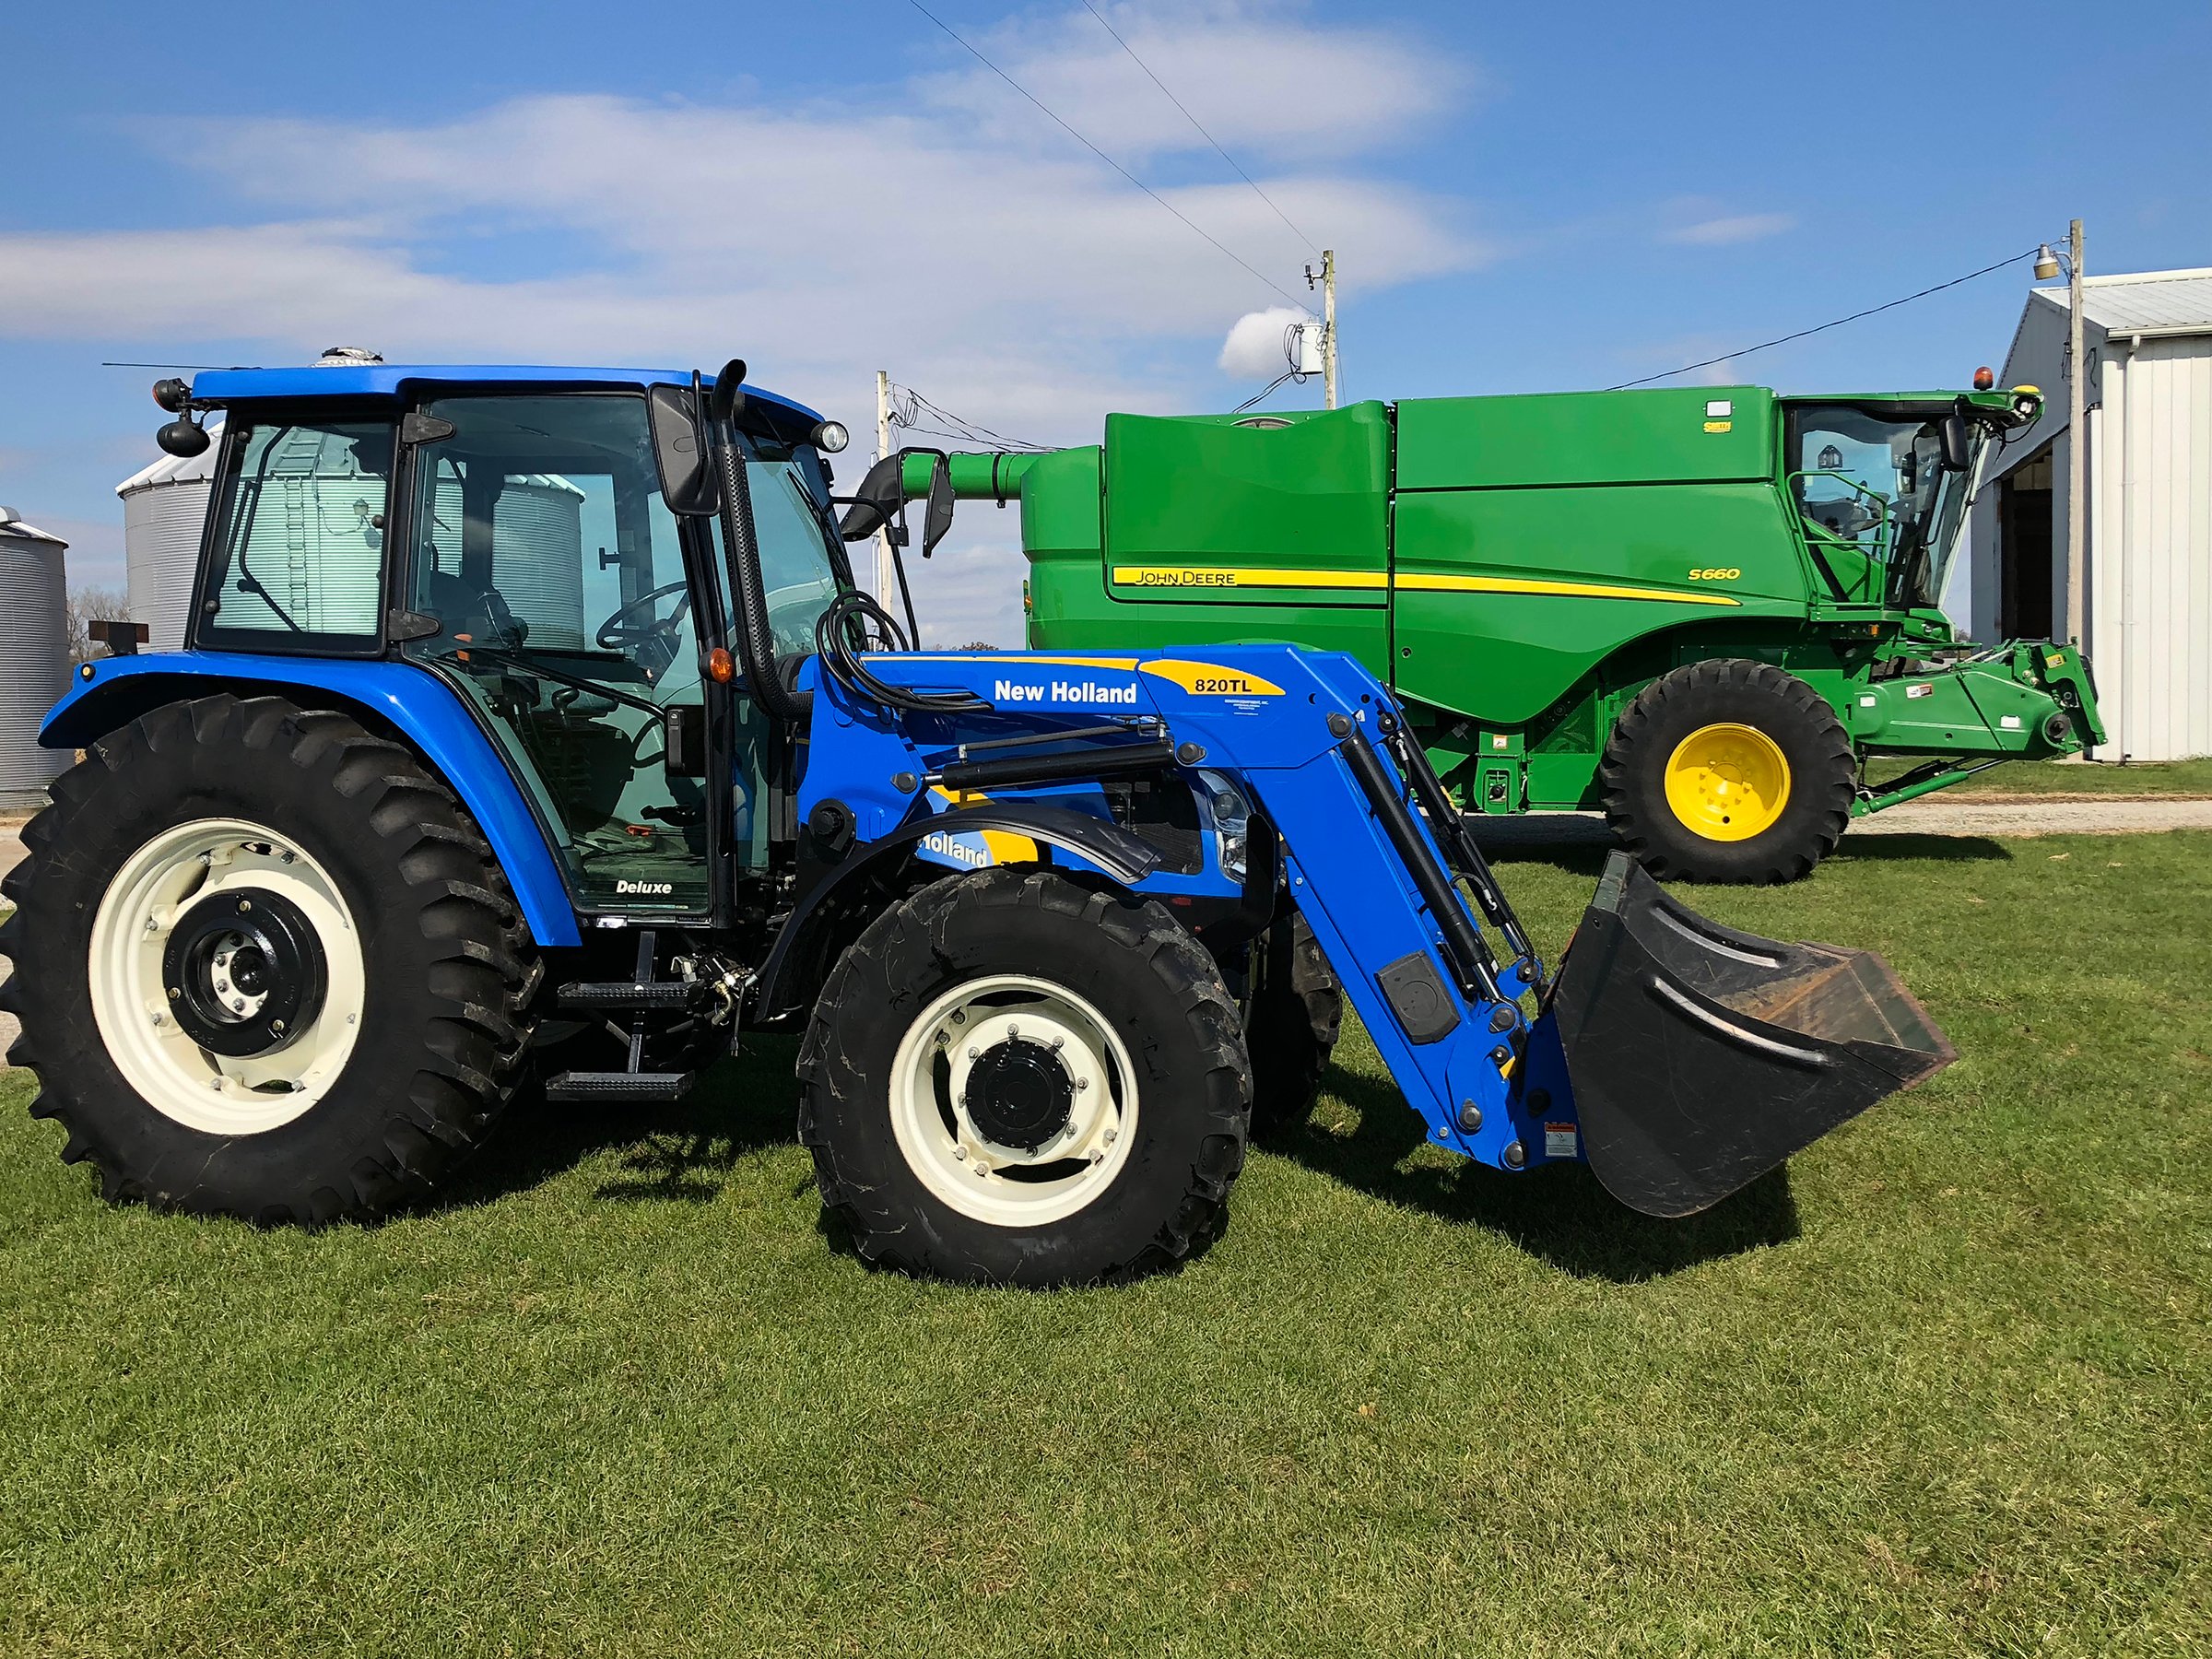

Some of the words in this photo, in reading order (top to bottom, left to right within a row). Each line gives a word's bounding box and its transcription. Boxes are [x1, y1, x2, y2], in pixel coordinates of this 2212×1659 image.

[1135, 571, 1178, 583] JOHN
[1182, 571, 1235, 584] DEERE
[1688, 568, 1741, 581] S660
[994, 680, 1044, 700] New
[1051, 681, 1136, 703] Holland
[1195, 679, 1253, 692] 820TL
[616, 879, 673, 894] Deluxe
